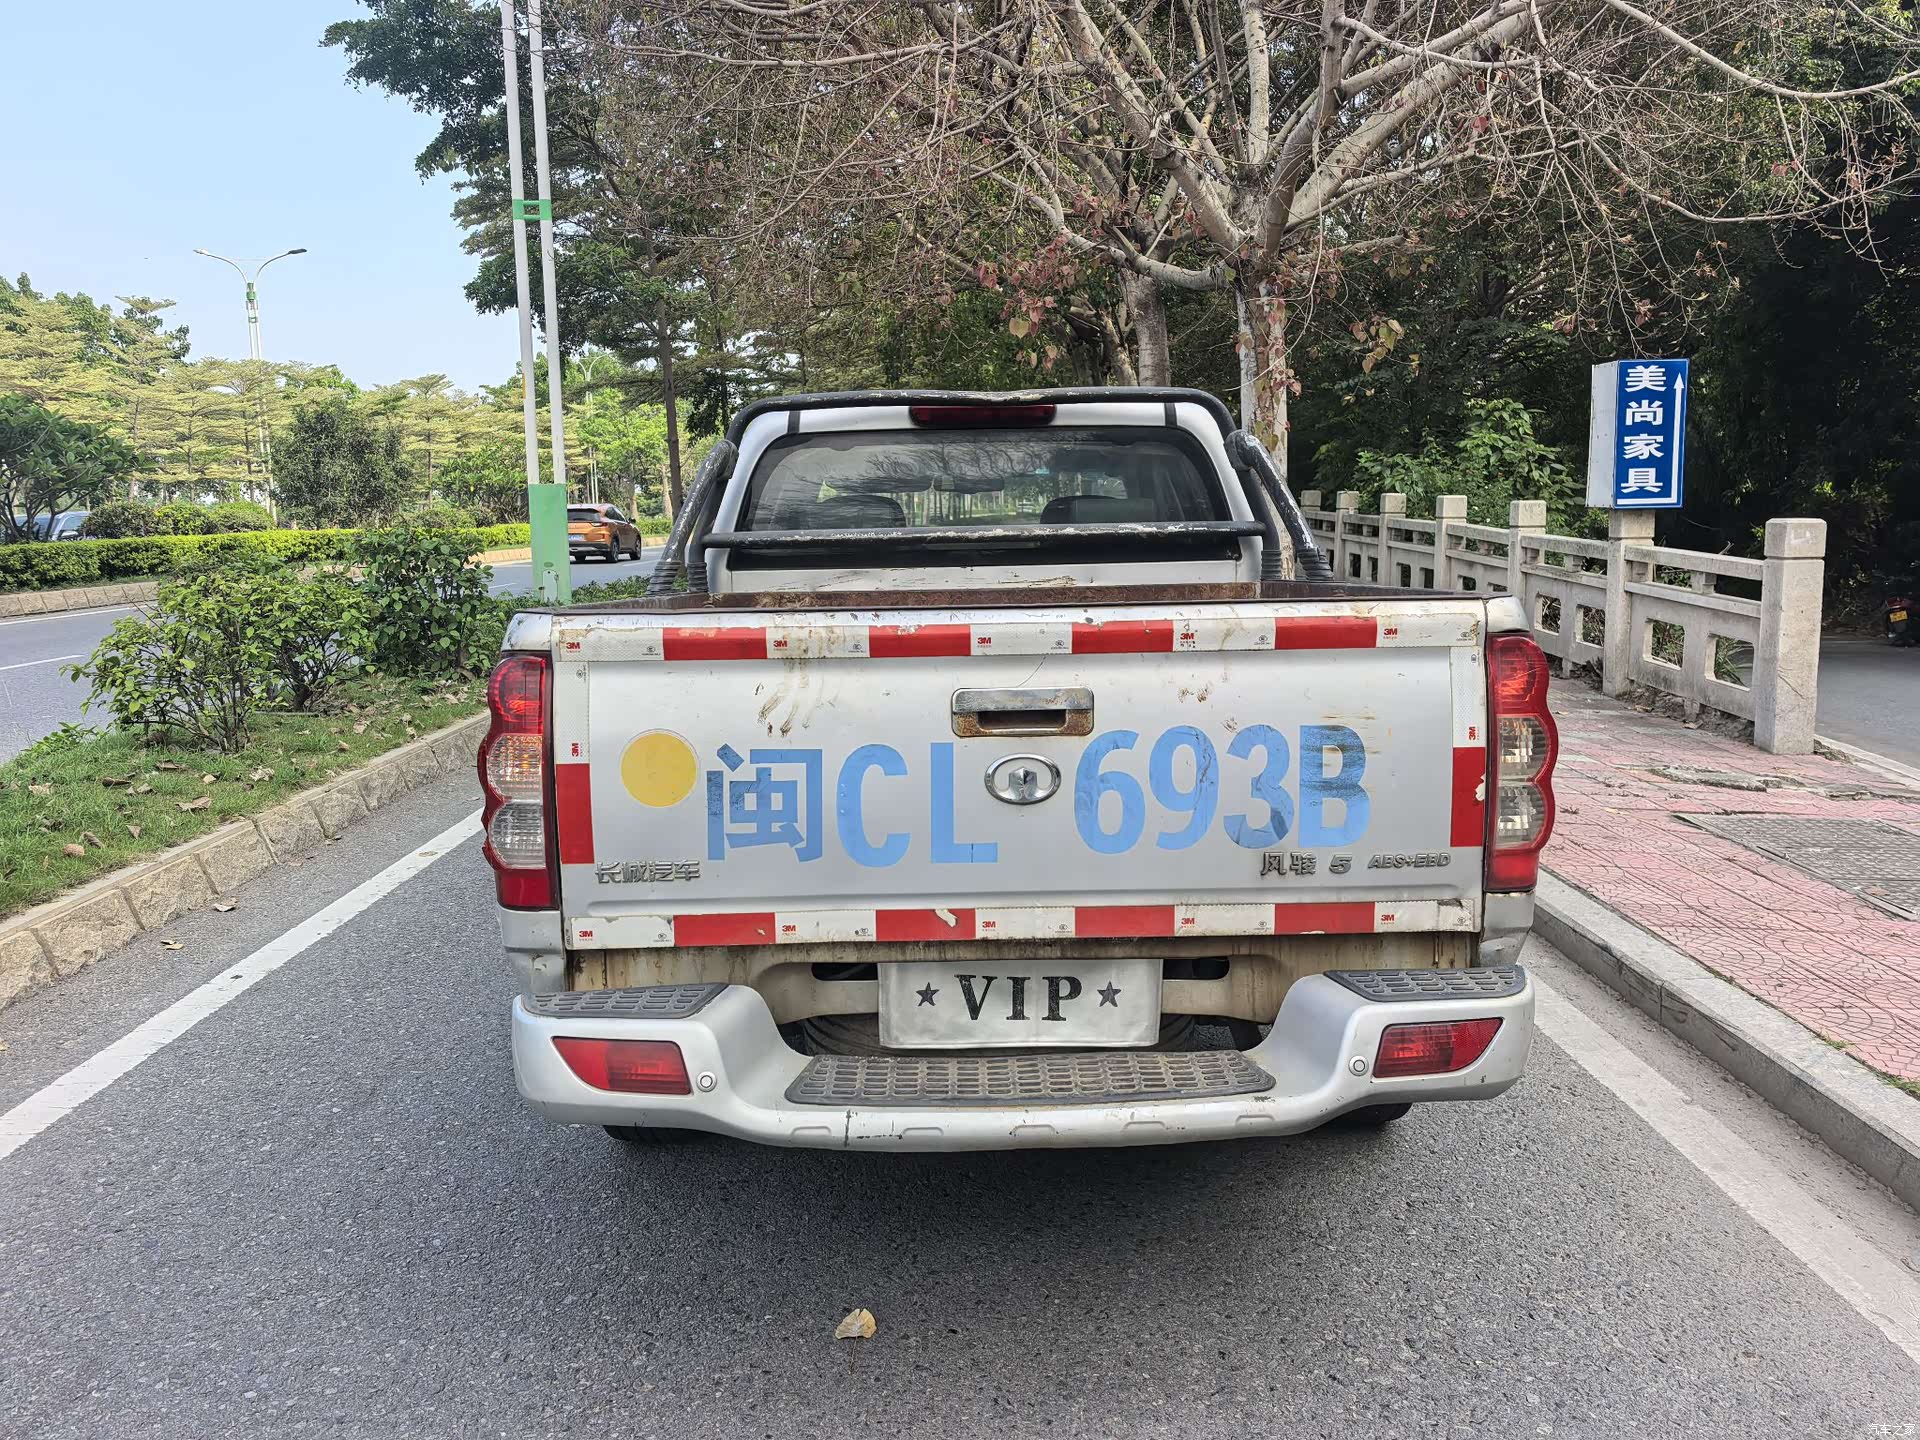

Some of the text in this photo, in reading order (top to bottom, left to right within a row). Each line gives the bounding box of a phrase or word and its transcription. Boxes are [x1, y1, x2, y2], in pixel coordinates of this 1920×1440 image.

[1620, 365, 1667, 493] 美尚家具
[1469, 727, 1476, 740] 3M
[572, 743, 579, 757] 3M
[1074, 724, 1371, 854] 693B
[595, 860, 700, 884] 长城汽车
[1261, 852, 1352, 876] 风骏 5
[1368, 853, 1451, 869] ABS+EBD
[954, 974, 1082, 1021] VIP
